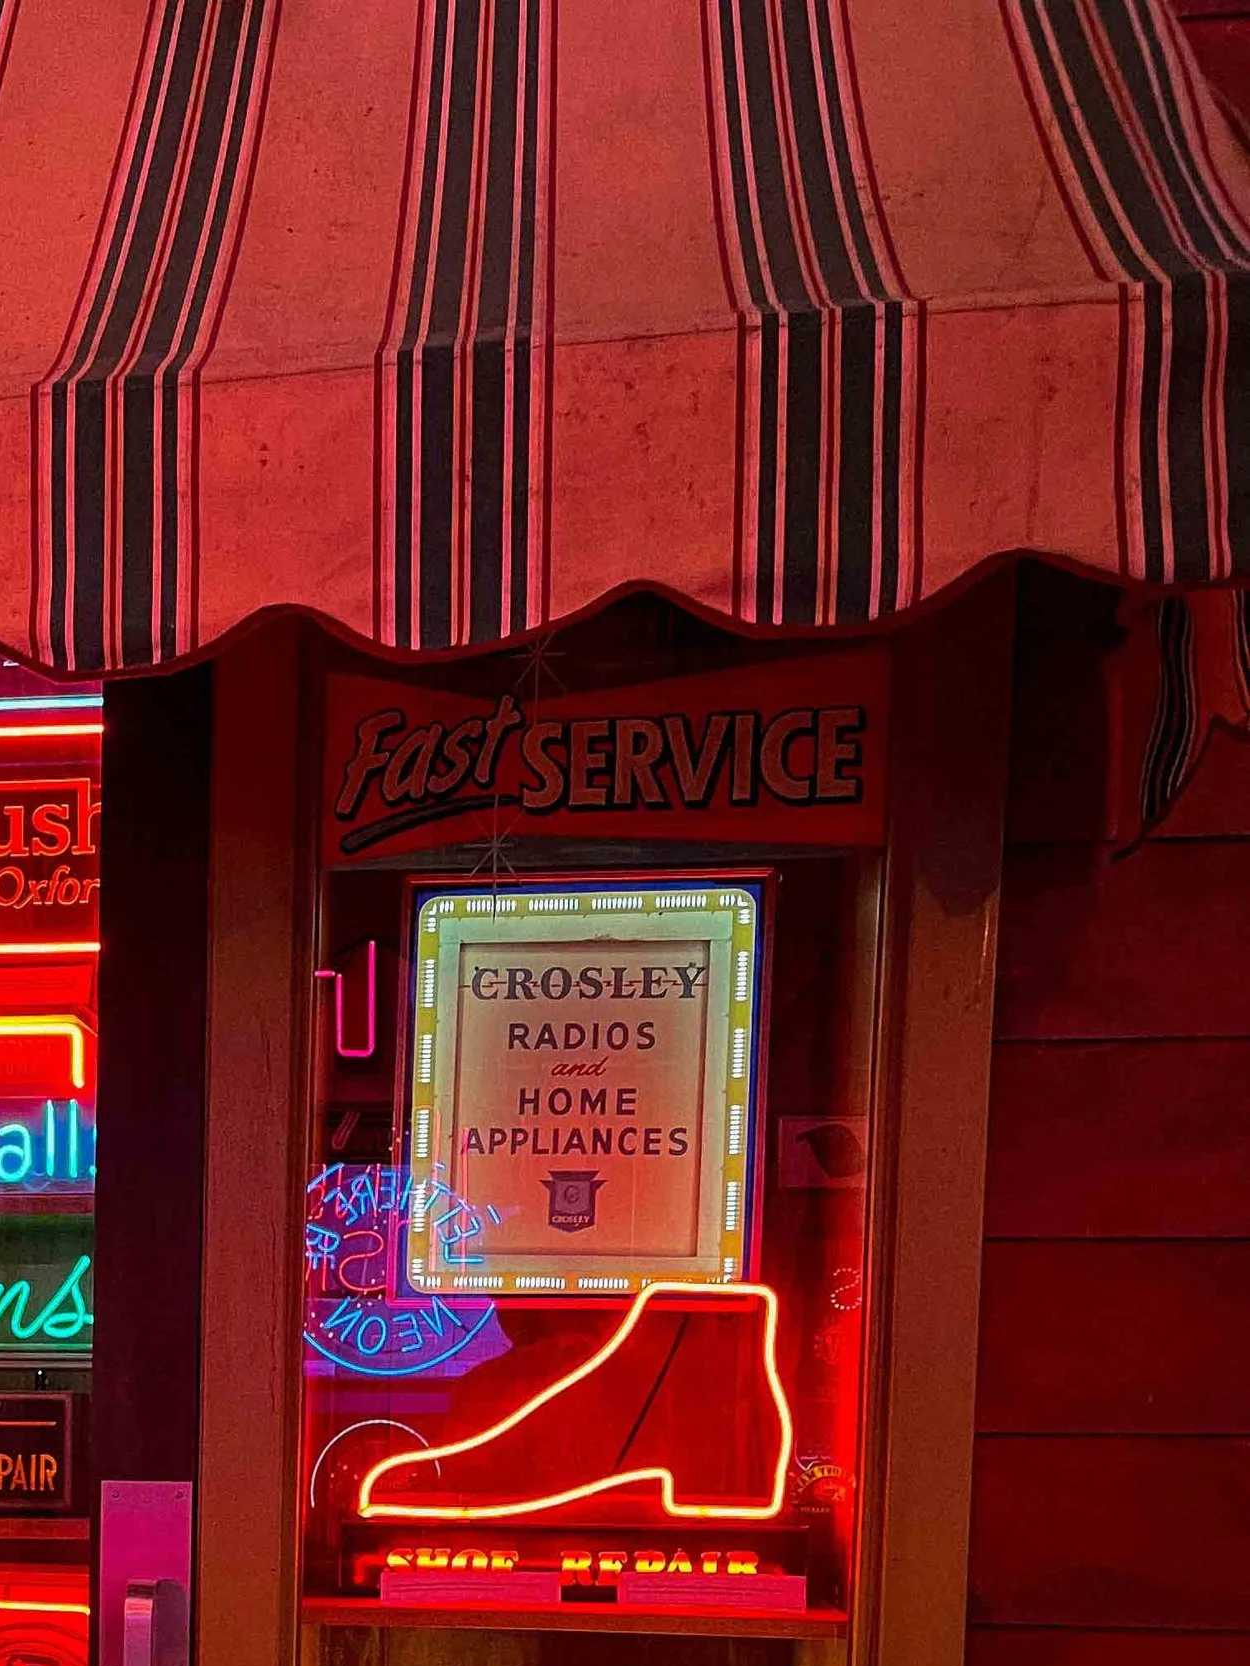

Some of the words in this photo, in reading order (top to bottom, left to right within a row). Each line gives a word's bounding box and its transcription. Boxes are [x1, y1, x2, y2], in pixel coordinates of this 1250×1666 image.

[335, 694, 523, 822] Fast
[519, 705, 867, 812] SERVICE
[471, 963, 706, 1001] CROSLEY
[507, 1021, 656, 1051] RADIOS
[552, 1057, 608, 1077] and
[518, 1088, 637, 1116] HOME
[463, 1127, 689, 1157] APPLIANCES
